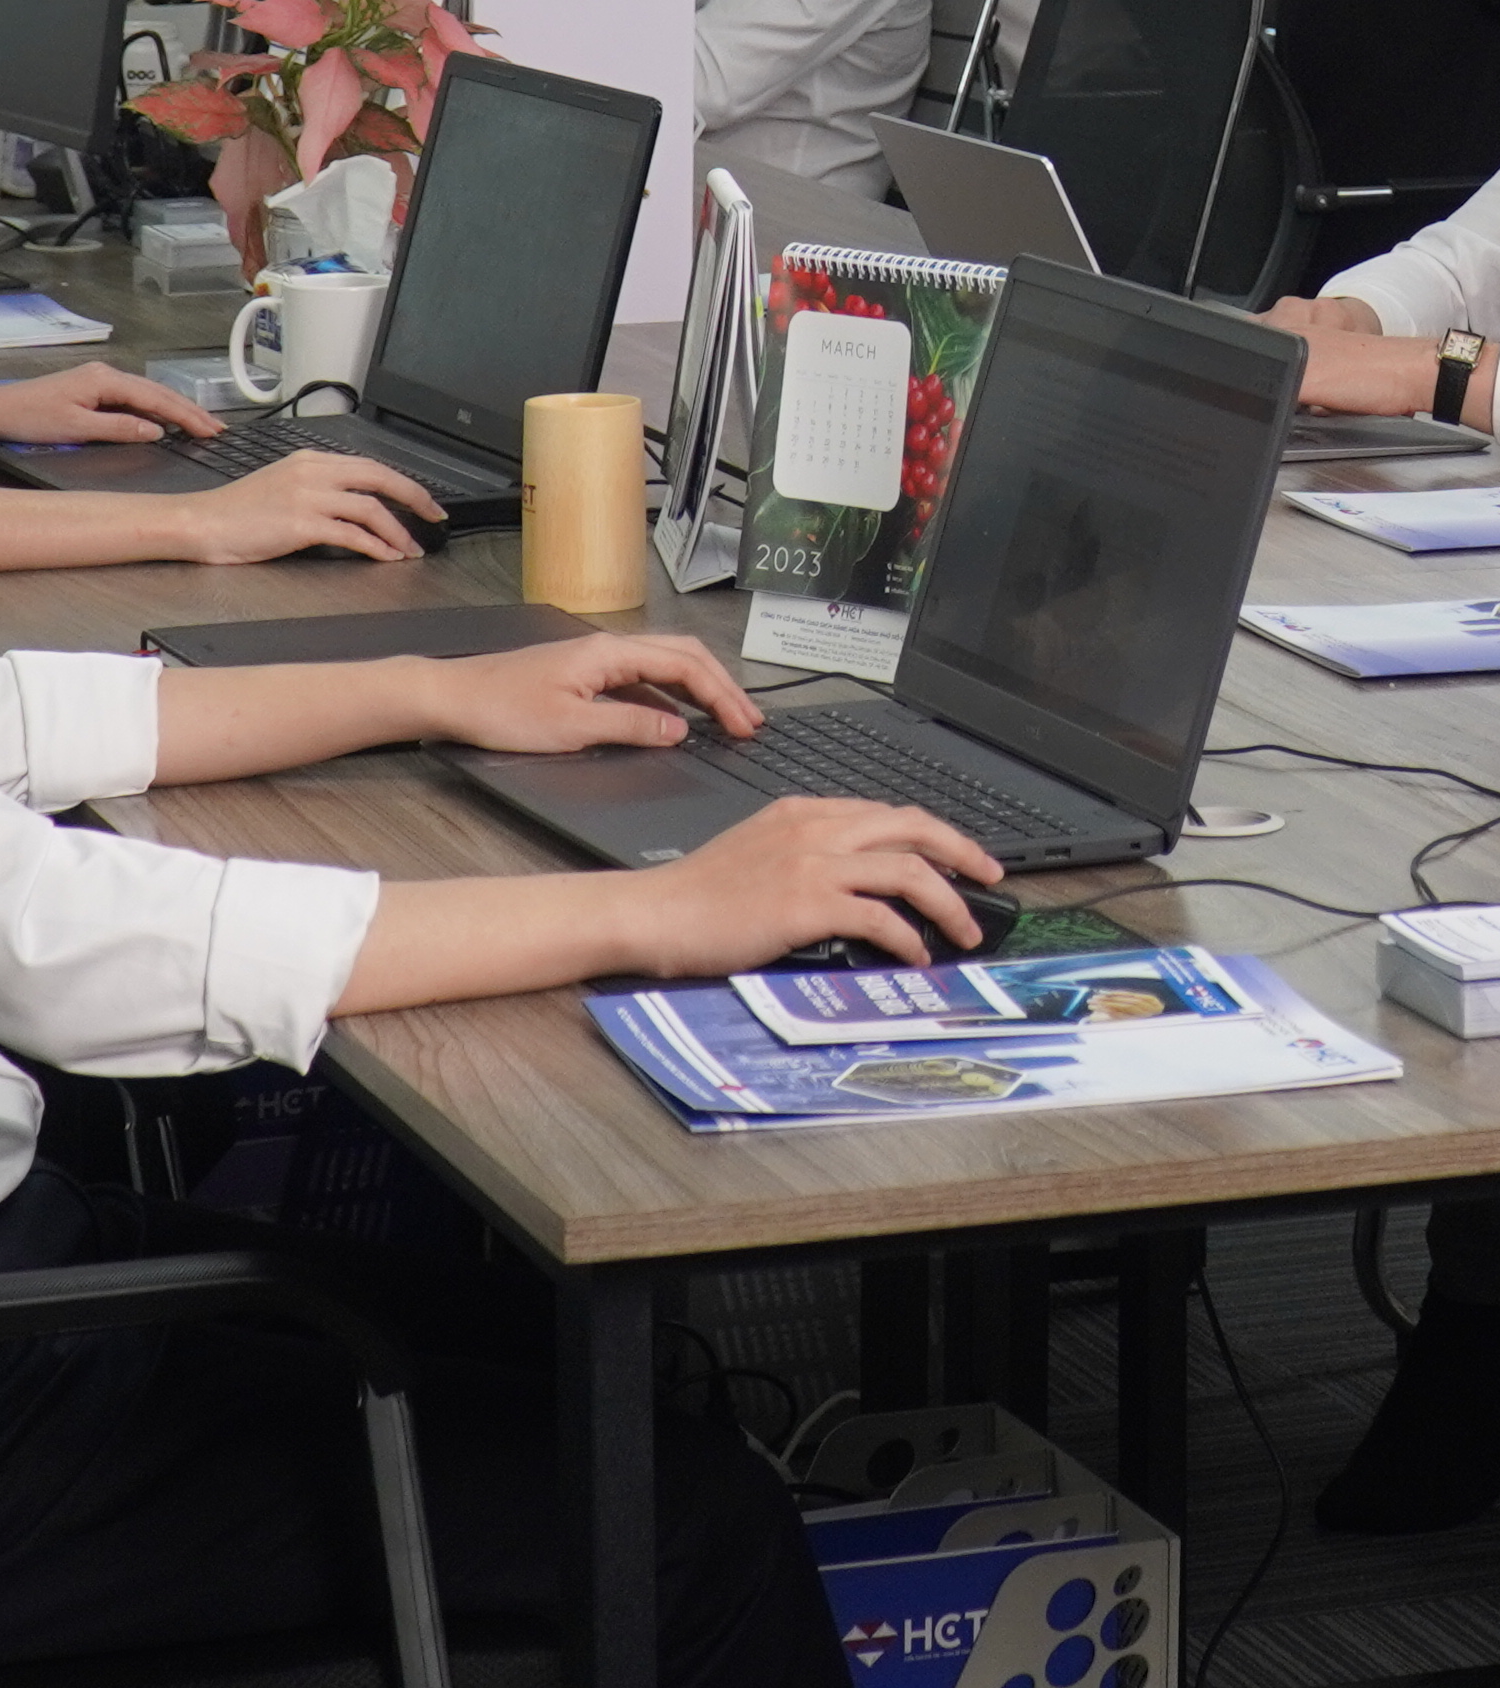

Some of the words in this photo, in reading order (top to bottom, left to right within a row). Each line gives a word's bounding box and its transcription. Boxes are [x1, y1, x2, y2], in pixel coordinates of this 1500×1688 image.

[821, 339, 877, 360] MARCH
[755, 543, 822, 577] 2023
[841, 604, 865, 621] HCT
[904, 1609, 989, 1655] HCT
